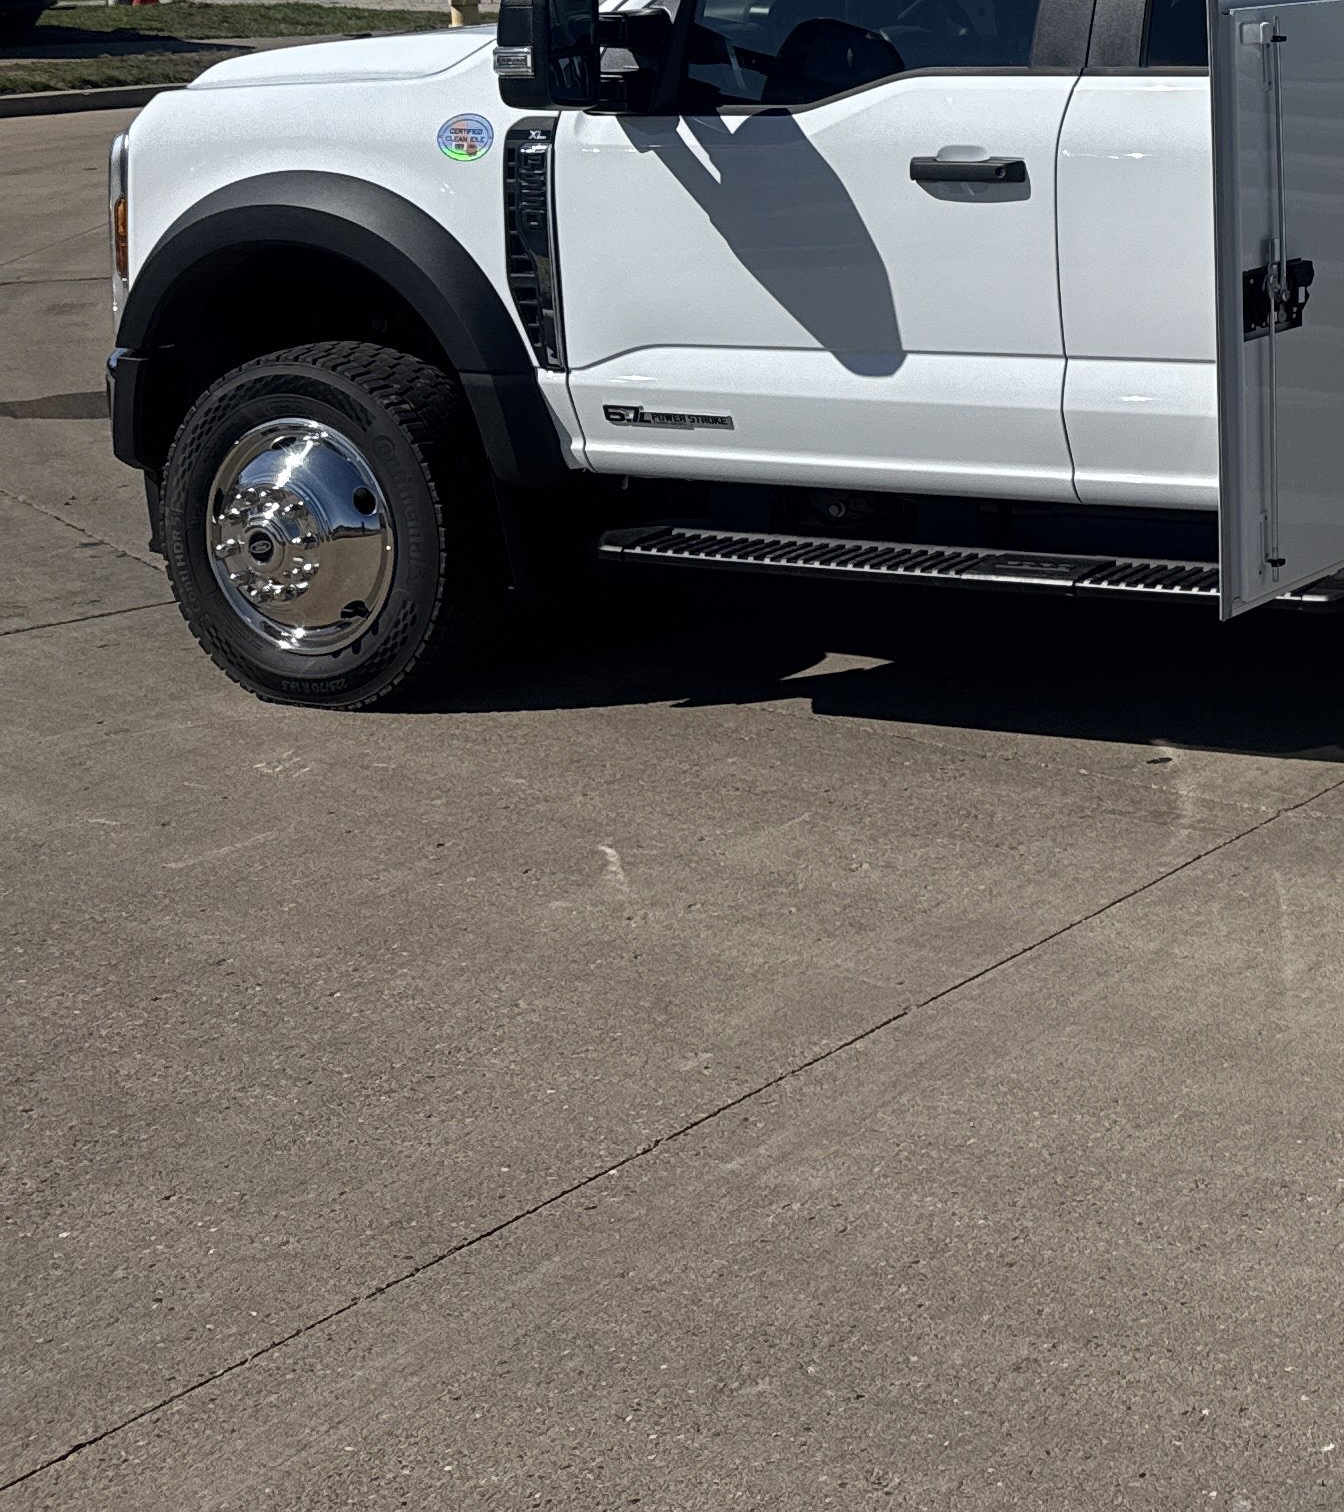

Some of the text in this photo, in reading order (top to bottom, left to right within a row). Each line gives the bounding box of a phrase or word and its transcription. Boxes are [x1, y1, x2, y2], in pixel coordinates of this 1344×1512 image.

[528, 130, 547, 139] XL
[651, 413, 687, 424] POWER
[687, 414, 729, 425] STROKE
